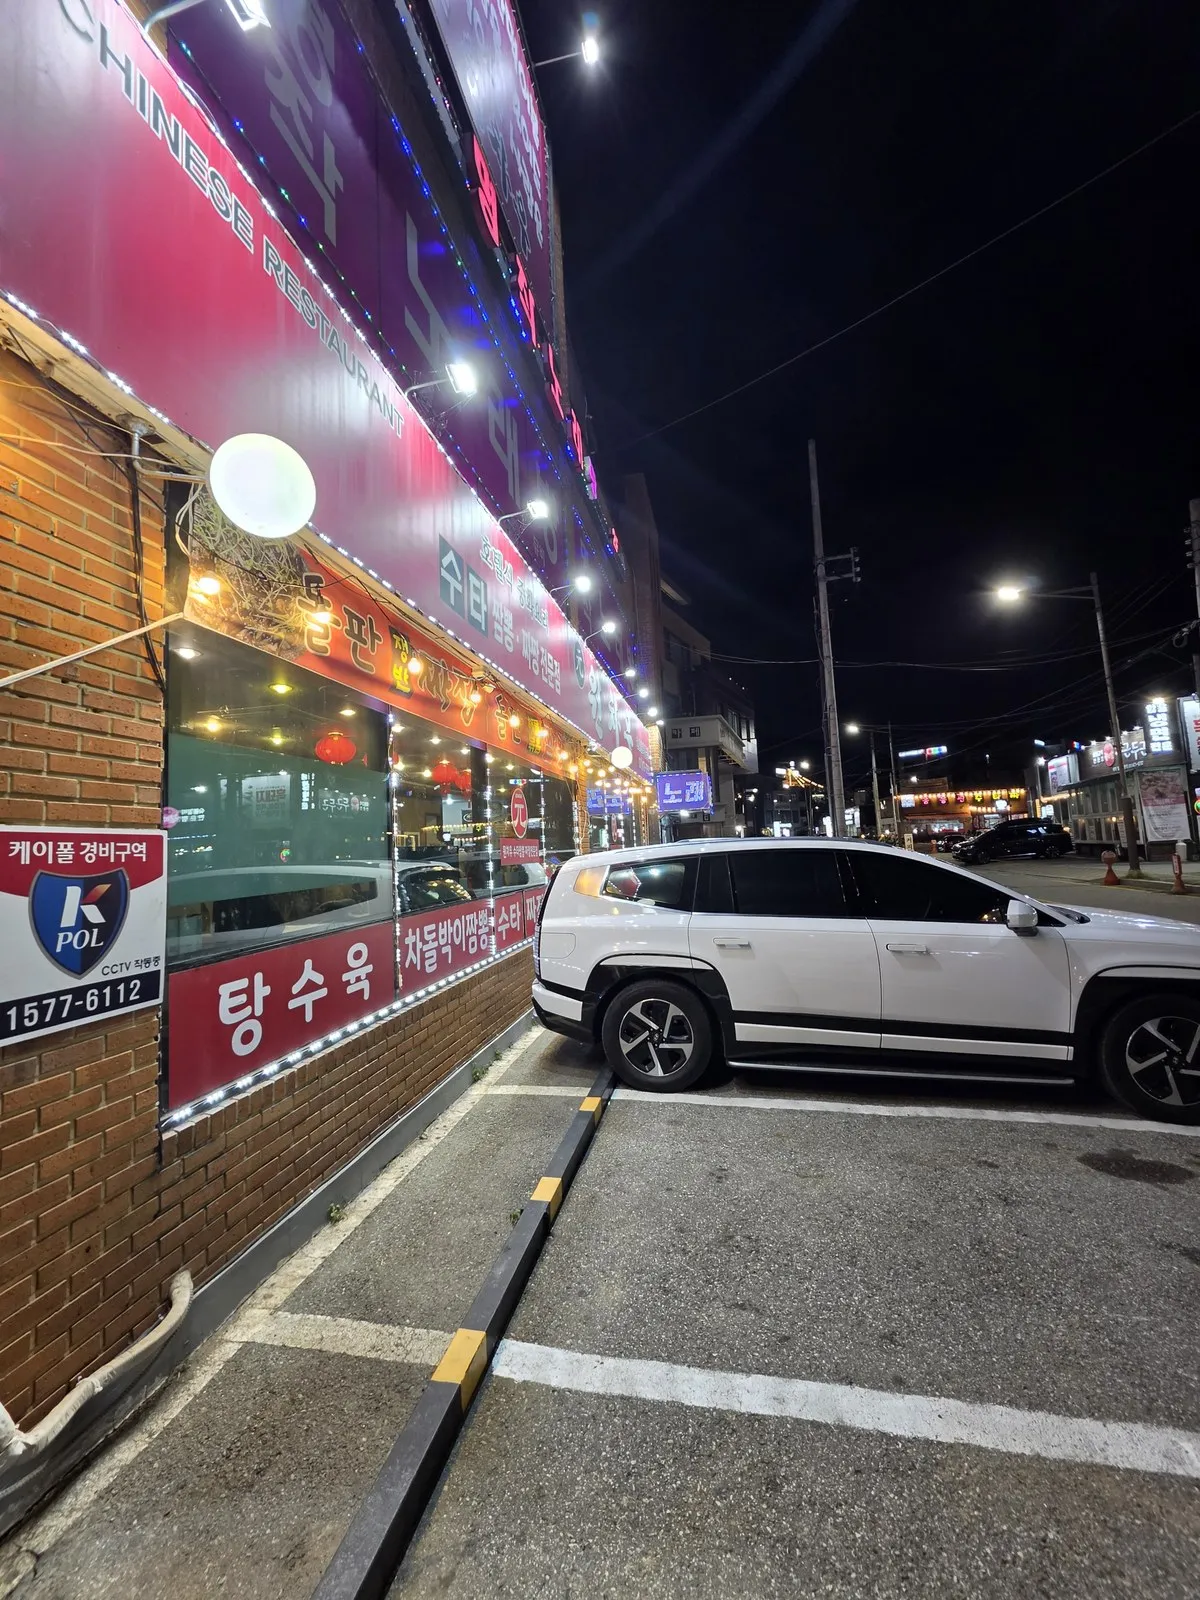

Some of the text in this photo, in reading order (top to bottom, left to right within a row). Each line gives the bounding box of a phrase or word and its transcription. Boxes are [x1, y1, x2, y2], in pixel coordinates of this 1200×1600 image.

[262, 234, 405, 439] RESTAURANT
[479, 533, 515, 593] 호텔식
[440, 550, 488, 631] 수타
[492, 598, 515, 653] 짬뽕
[540, 647, 562, 697] 전문점
[9, 841, 147, 864] 케이폴 경비구역
[55, 929, 104, 953] POL
[404, 908, 488, 974] 차돌박이짬뽕
[497, 901, 521, 941] 수타
[101, 956, 161, 976] CCTV 작동중
[5, 979, 141, 1031] 1577-6112
